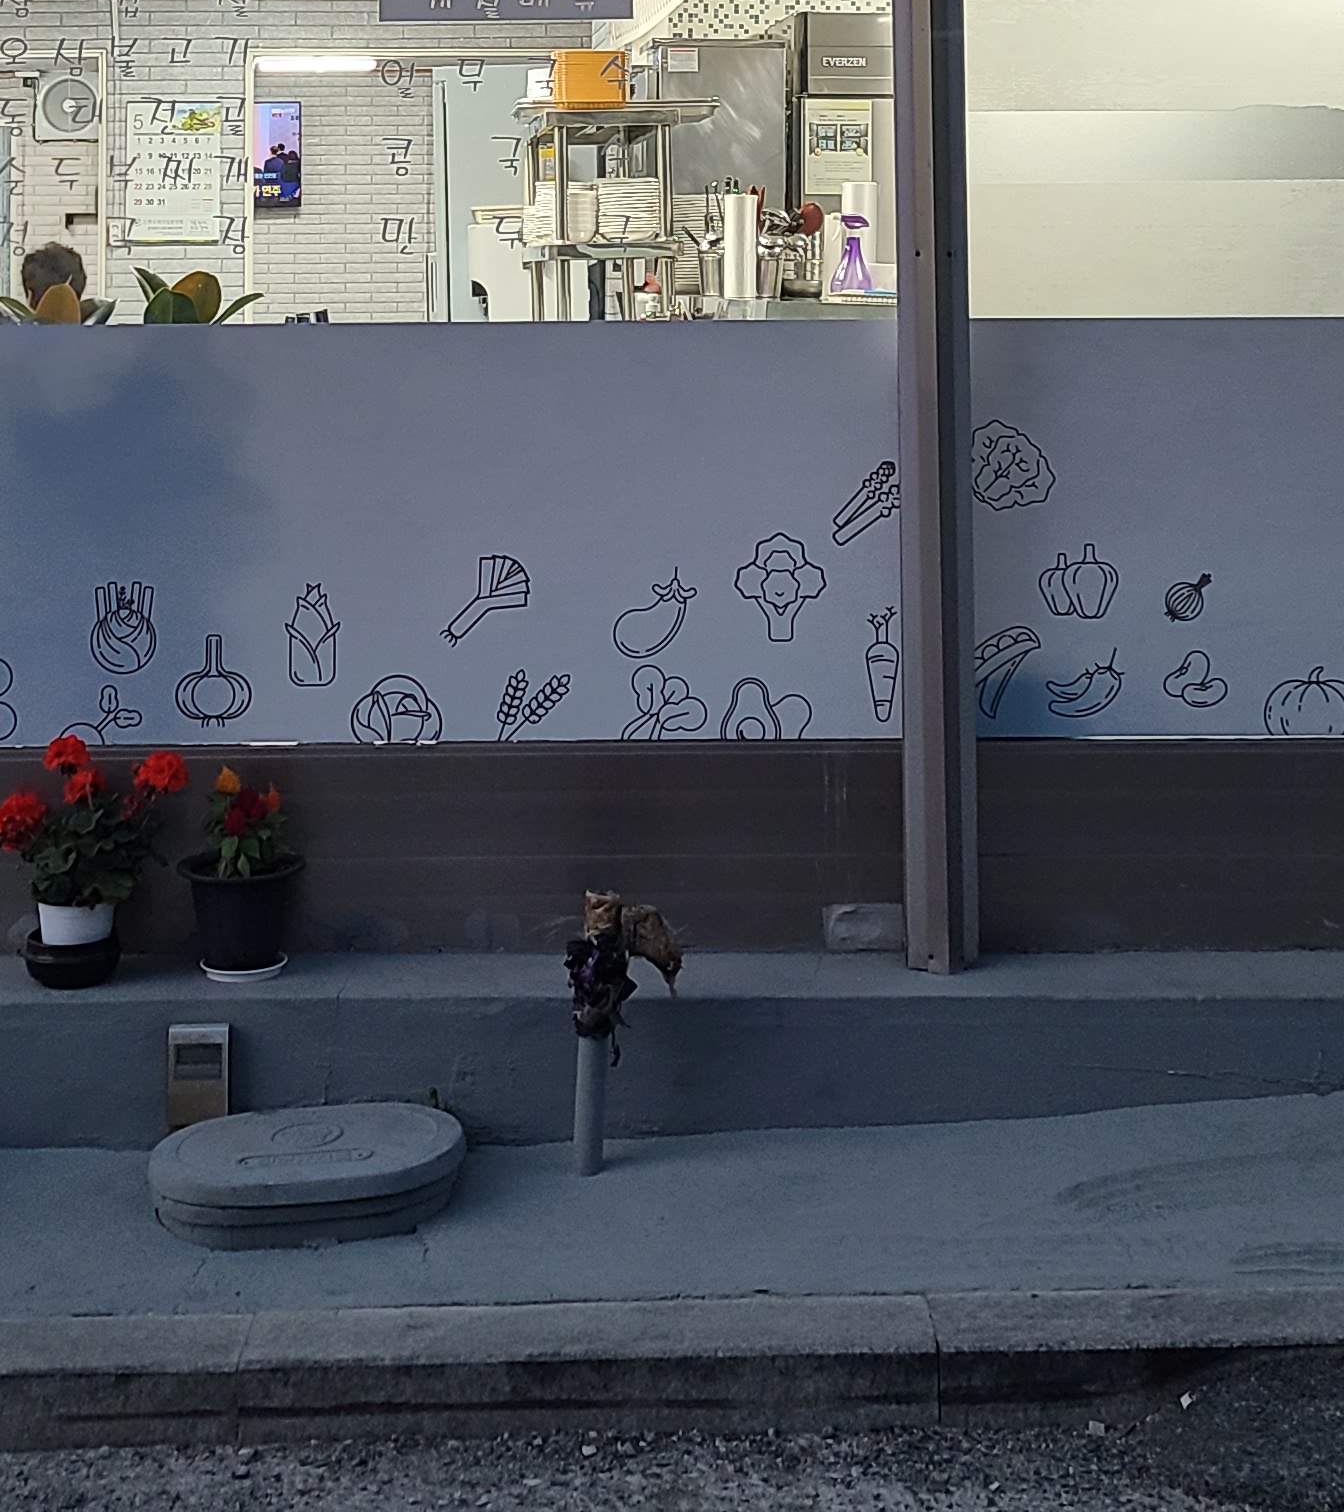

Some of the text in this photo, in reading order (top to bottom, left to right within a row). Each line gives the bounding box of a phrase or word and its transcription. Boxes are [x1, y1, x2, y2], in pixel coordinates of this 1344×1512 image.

[0, 37, 250, 77] 오삼불고기
[822, 57, 867, 67] EVERZEN
[133, 113, 144, 130] 5
